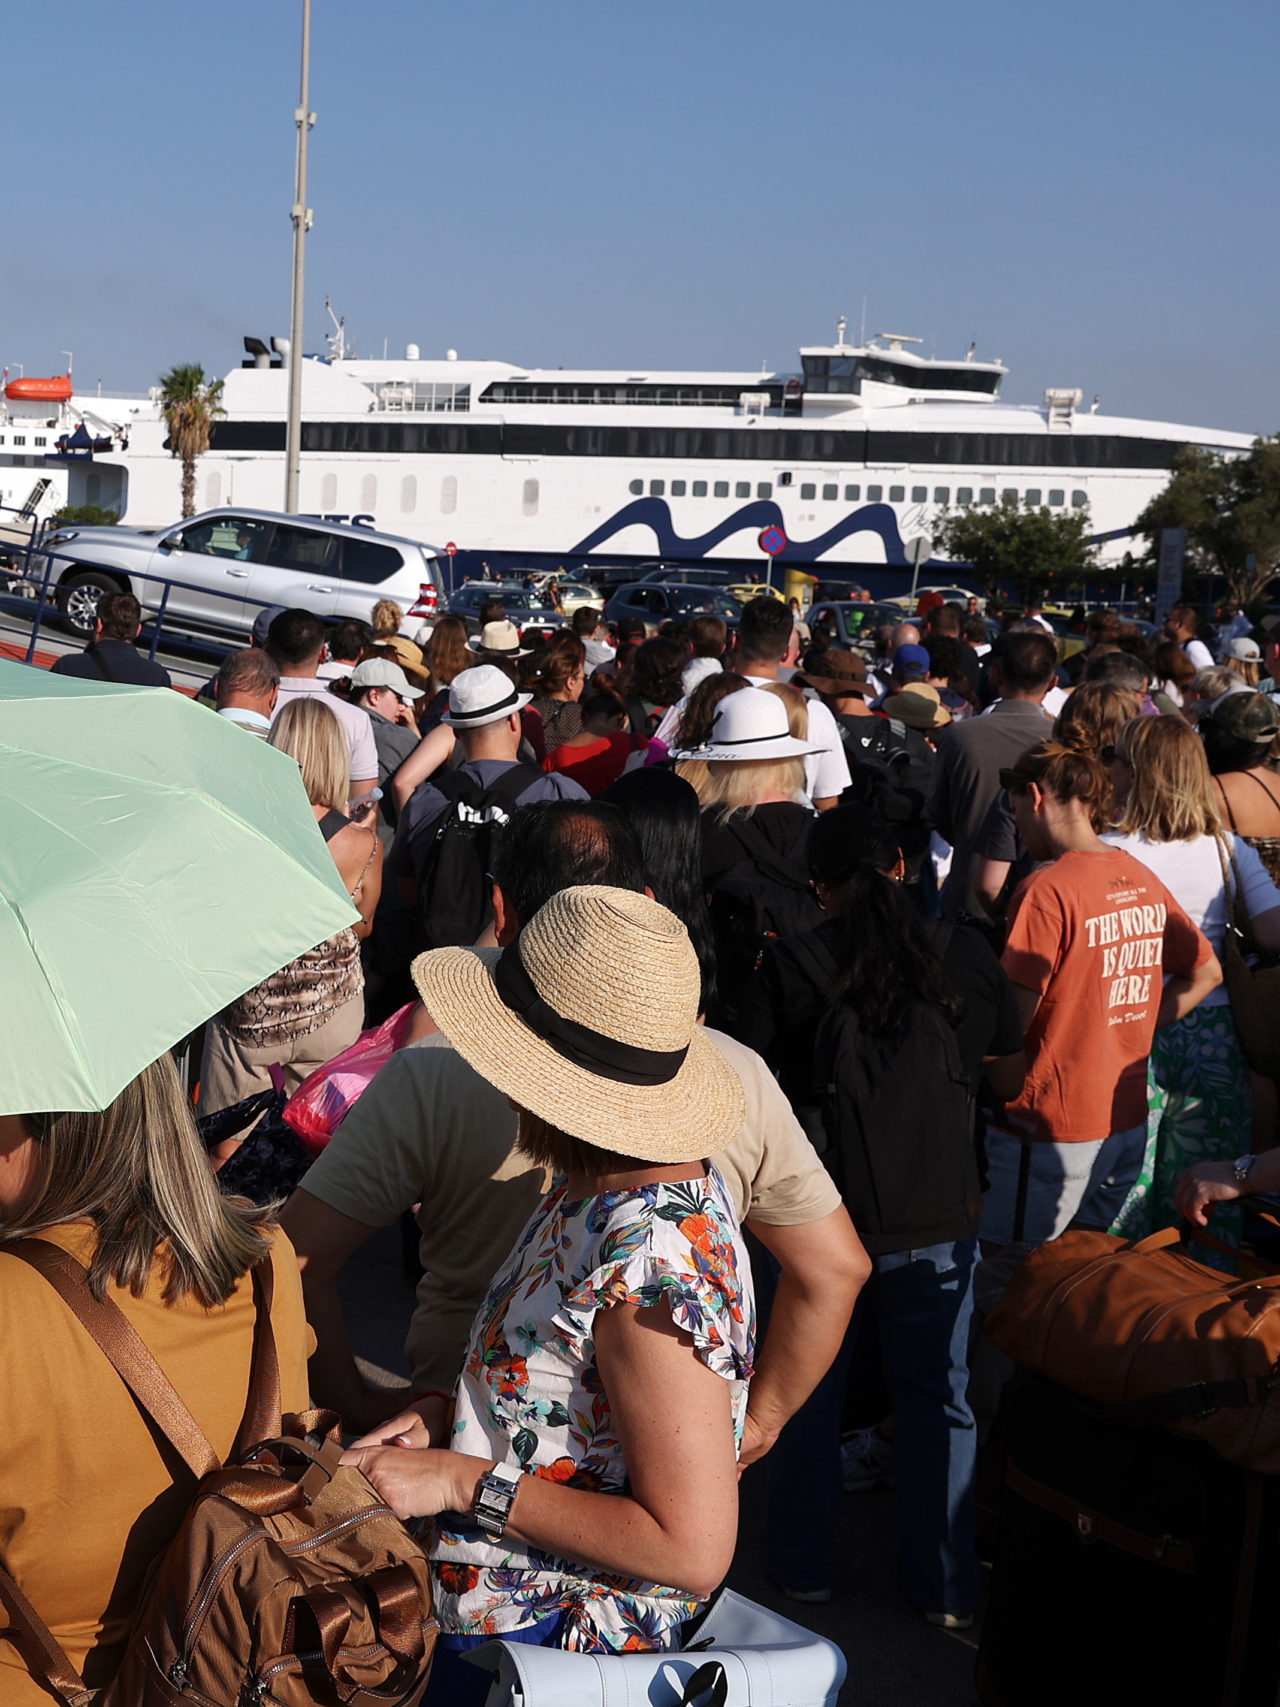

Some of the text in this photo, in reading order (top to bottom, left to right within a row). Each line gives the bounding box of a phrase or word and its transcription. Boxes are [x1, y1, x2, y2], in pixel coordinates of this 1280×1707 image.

[1085, 911, 1120, 948] THE
[1101, 937, 1163, 978] IS QUIET
[1108, 974, 1152, 1008] HERE
